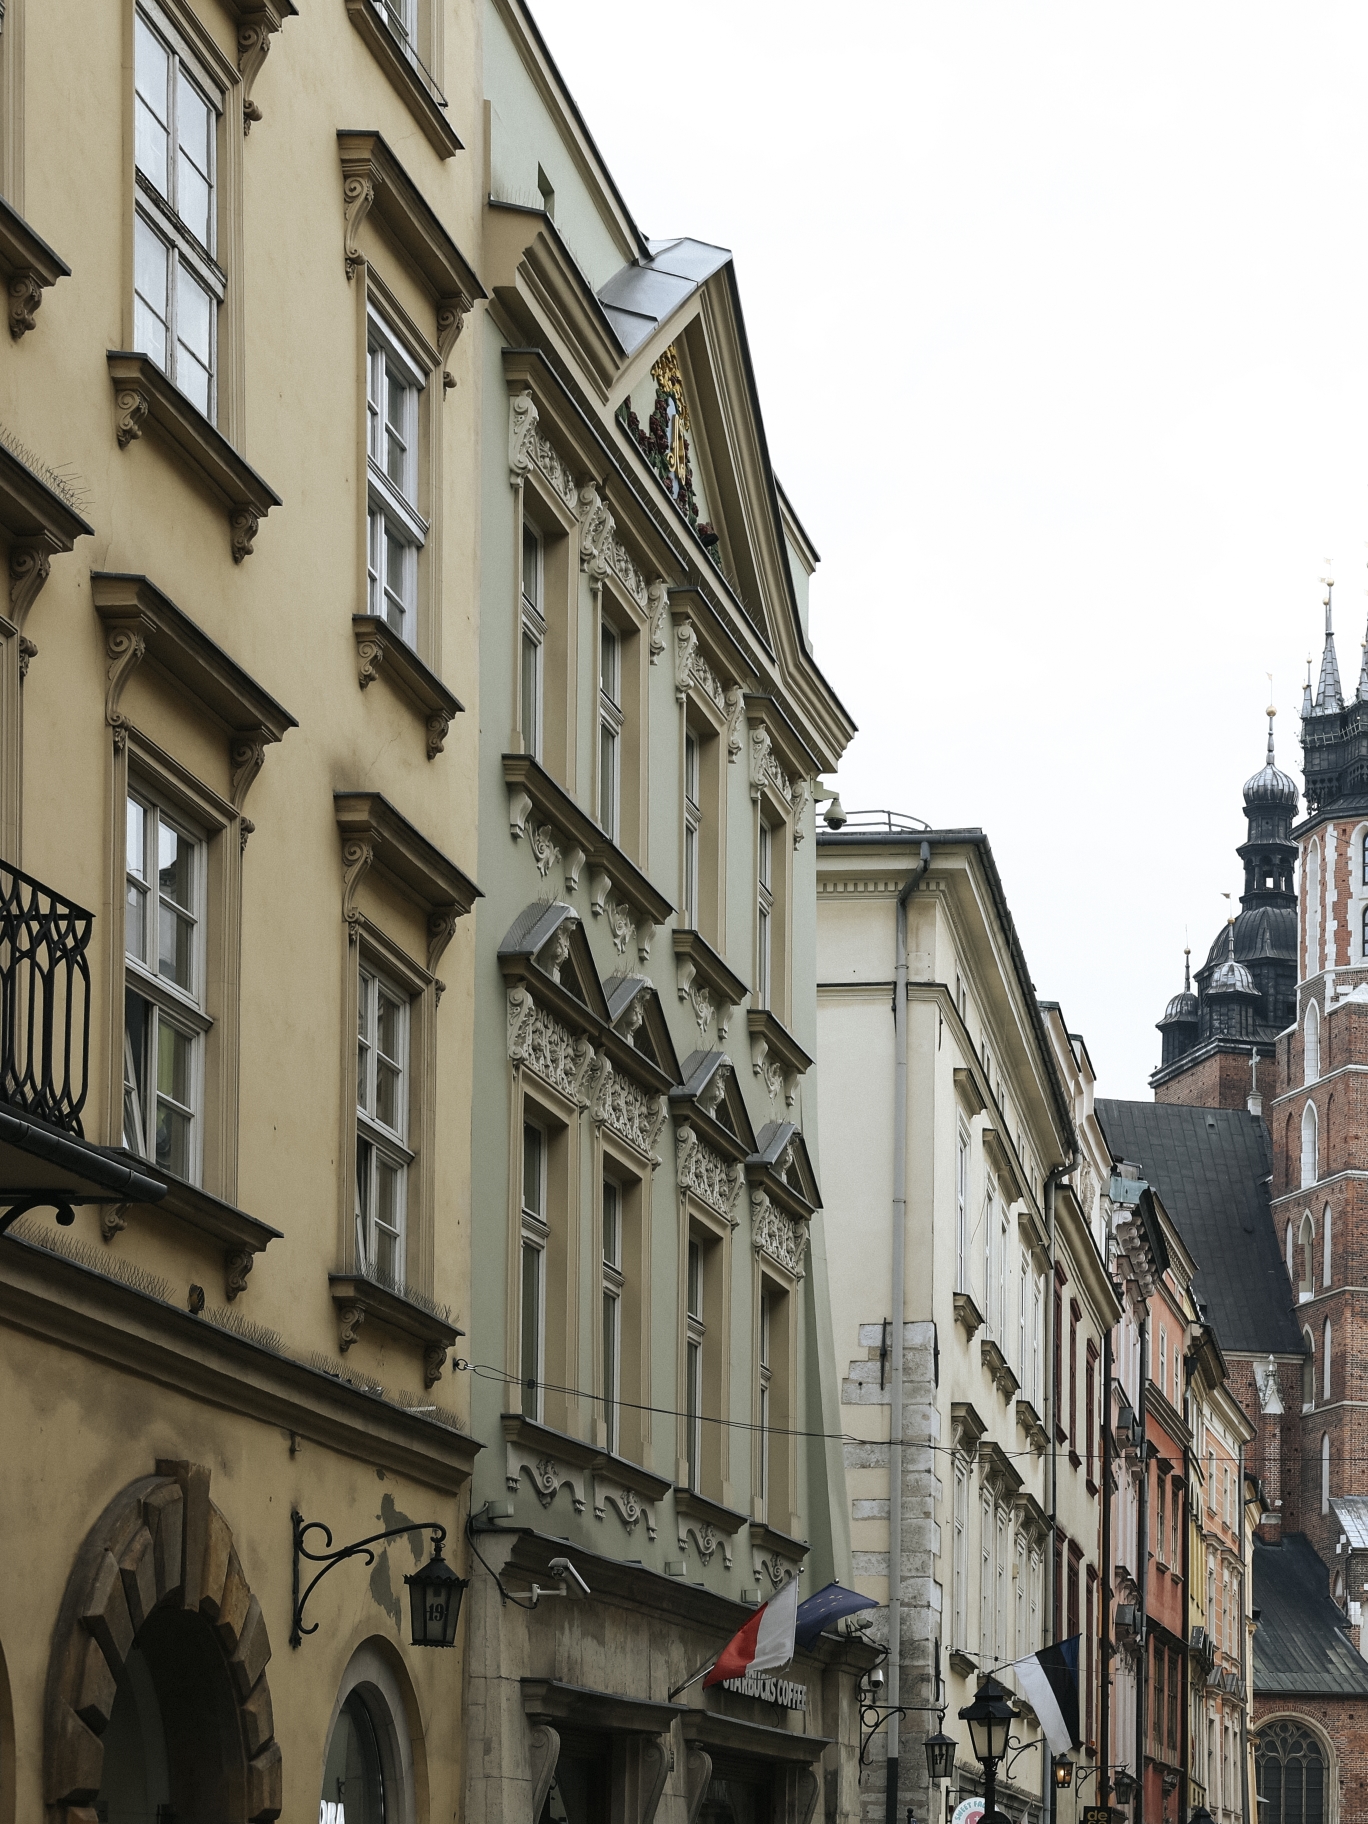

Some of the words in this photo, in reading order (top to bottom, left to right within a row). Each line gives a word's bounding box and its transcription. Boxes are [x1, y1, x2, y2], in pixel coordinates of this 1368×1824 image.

[428, 1603, 445, 1621] 19
[777, 1679, 807, 1711] COFFEE
[1087, 1810, 1108, 1821] de
